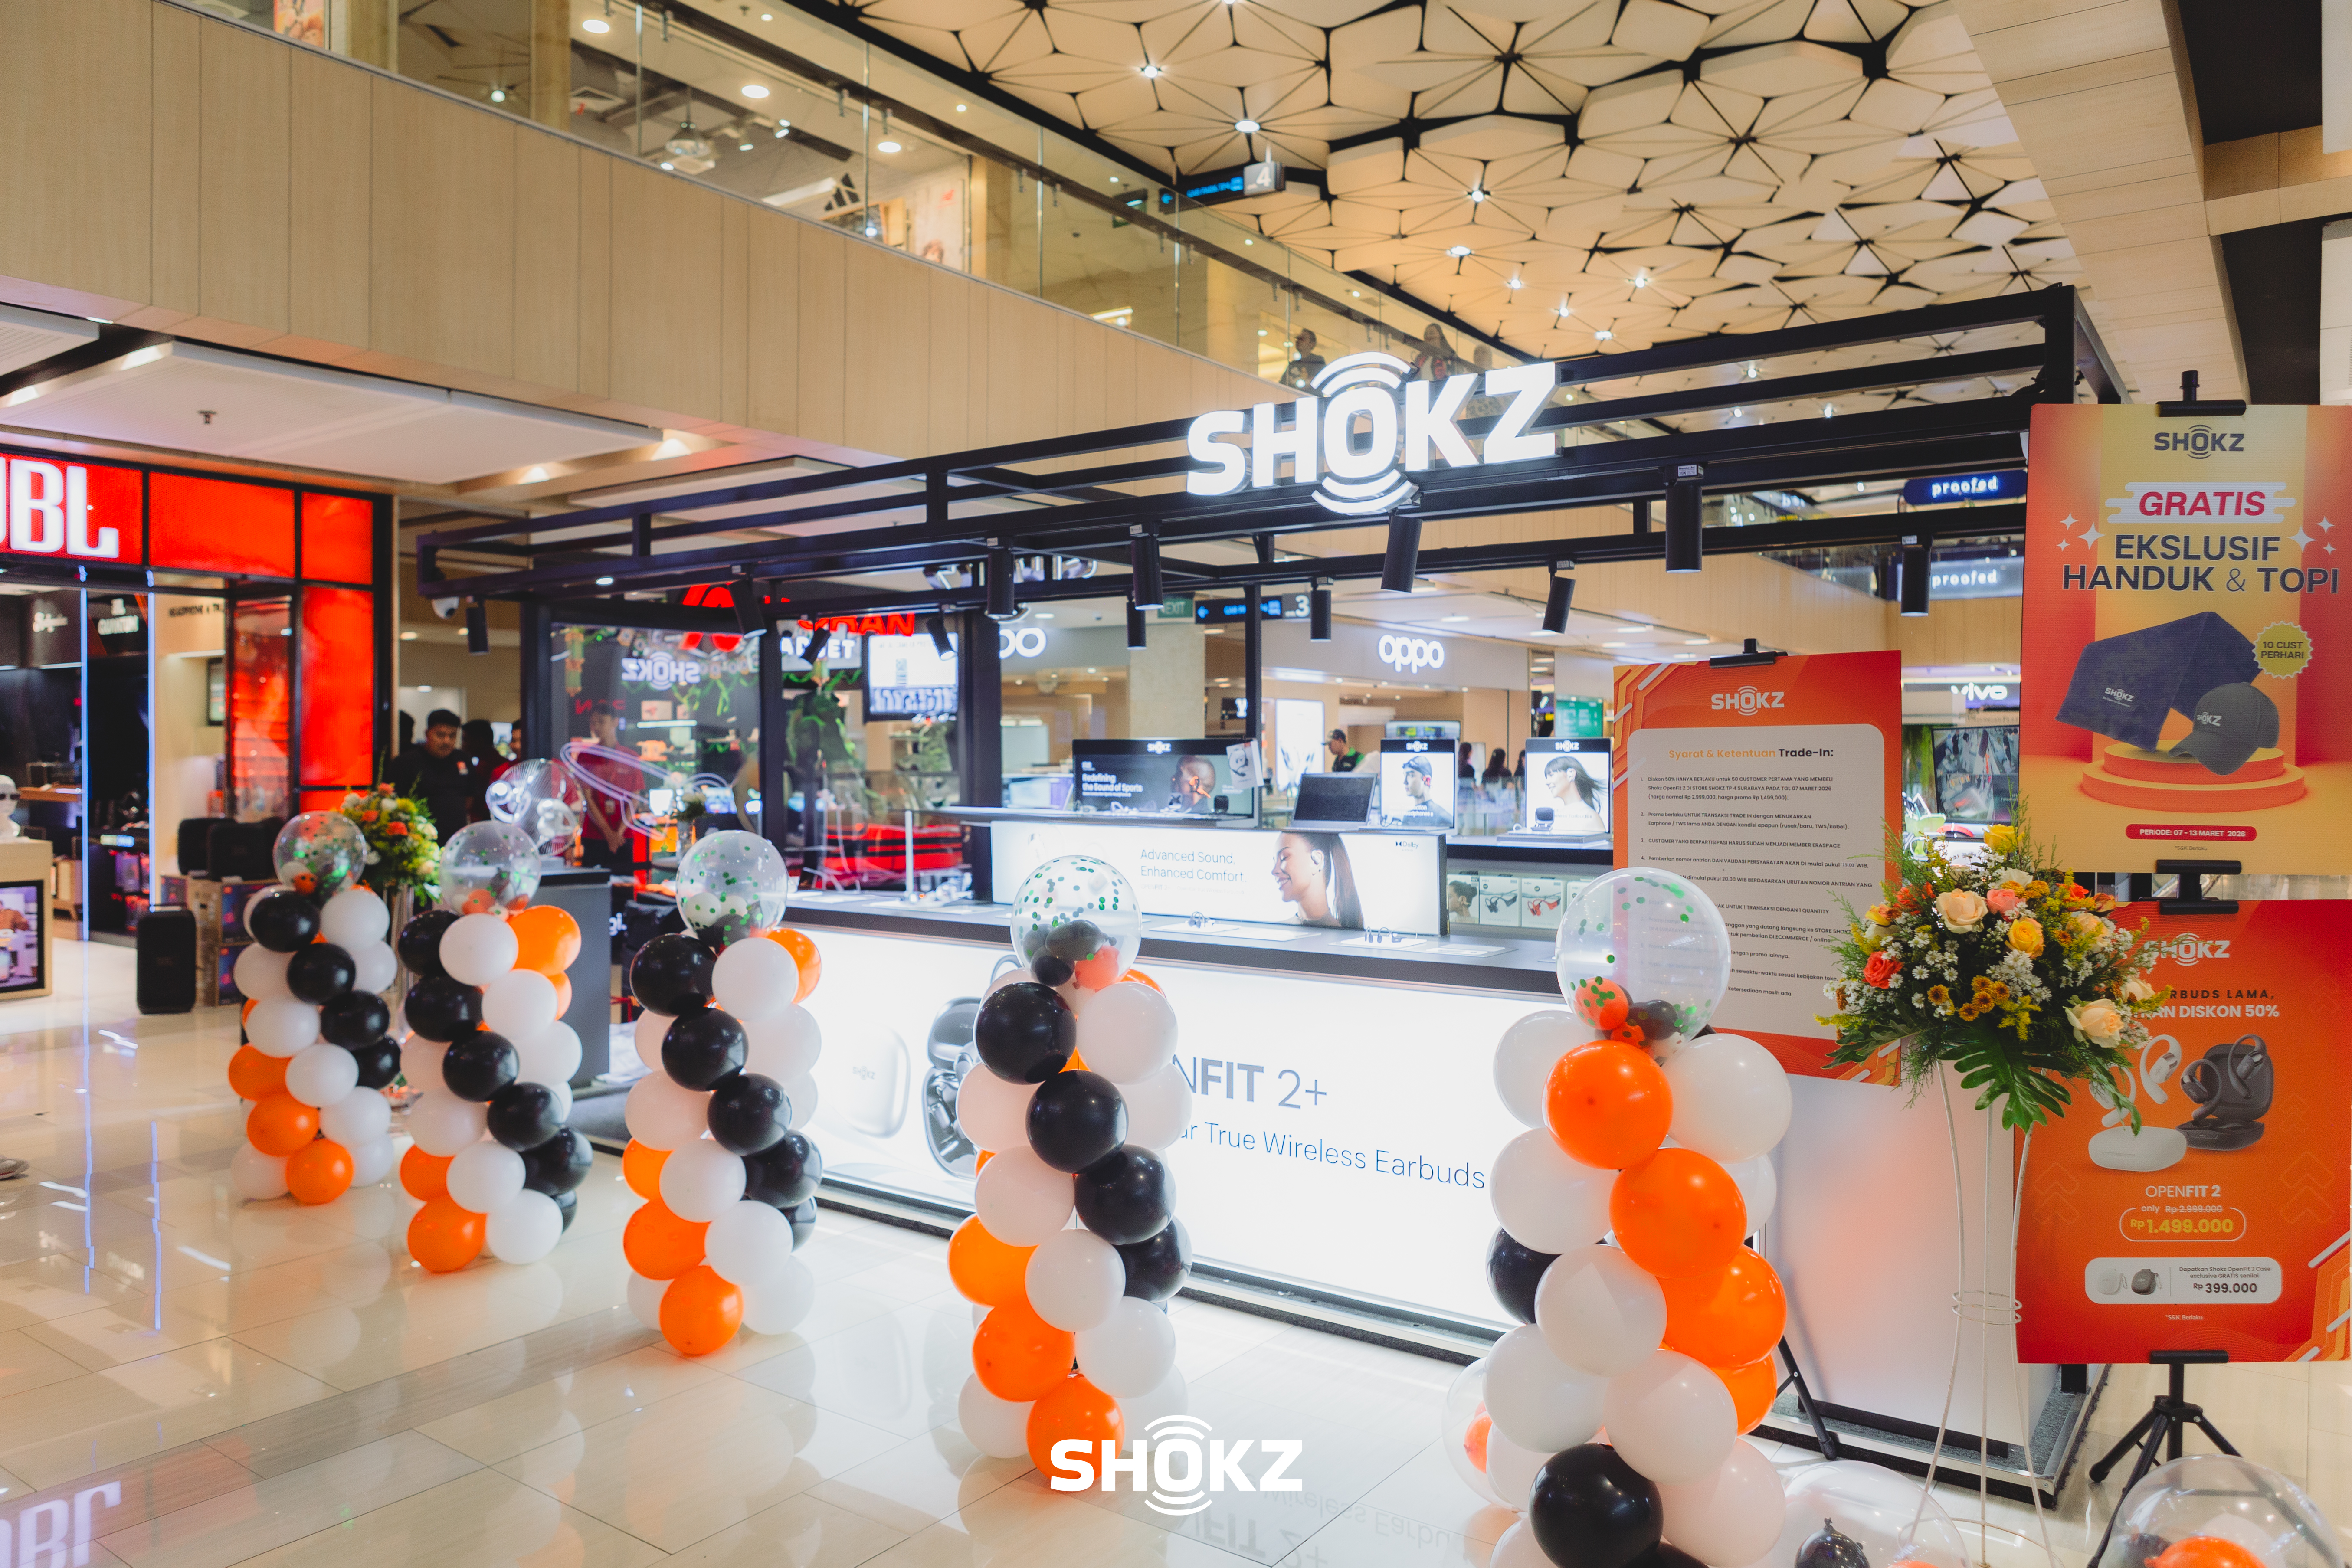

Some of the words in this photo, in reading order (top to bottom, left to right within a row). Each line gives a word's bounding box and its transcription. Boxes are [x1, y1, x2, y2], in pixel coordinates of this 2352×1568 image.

[1186, 361, 1556, 495] SHOKZ
[2153, 432, 2244, 452] SHOKZ
[1931, 476, 1998, 499] proofed
[0, 456, 119, 559] BL
[2139, 491, 2266, 516] GRATIS
[2115, 534, 2280, 561] EKSLUSIF
[1931, 569, 1998, 589] proofed
[2063, 565, 2214, 591] HANDUK
[2226, 568, 2245, 592] &
[2257, 567, 2339, 593] TOPI
[1295, 594, 1310, 618] 3
[1378, 634, 1445, 674] oppo
[2261, 651, 2304, 659] PERHARI
[1711, 691, 1785, 710] SHOKZ
[2104, 687, 2135, 702] SHOKZ
[2196, 714, 2222, 727] SHOKZ
[1147, 742, 1171, 753] SHOKZ
[1669, 750, 1704, 761] Syarat
[1706, 749, 1714, 758] &
[1717, 749, 1776, 758] Ketentuan
[1778, 748, 1834, 757] Trade-In:
[1141, 849, 1194, 862] Advanced
[1198, 851, 1235, 864] Sound,
[1141, 865, 1193, 879] Enhanced
[1196, 869, 1247, 882] Comfort.
[2144, 940, 2231, 959] HOKZ
[2170, 990, 2219, 999] RBUDS
[2227, 989, 2274, 1000] LAMA,
[2179, 1005, 2241, 1018] DISKON
[2245, 1005, 2280, 1017] 50%
[1171, 1054, 1264, 1103] NFIT
[1278, 1069, 1327, 1110] 2+
[1205, 1122, 1255, 1150] True
[1263, 1131, 1366, 1169] Wireless
[1376, 1149, 1484, 1189] Earbuds
[2146, 1185, 2208, 1198] OPENFIT
[2211, 1185, 2221, 1197] 2
[2141, 1204, 2160, 1214] only
[2165, 1205, 2177, 1214] Rp
[2130, 1219, 2145, 1230] Rp
[2147, 1219, 2233, 1233] 1.499.000
[2205, 1283, 2257, 1293] 399.000
